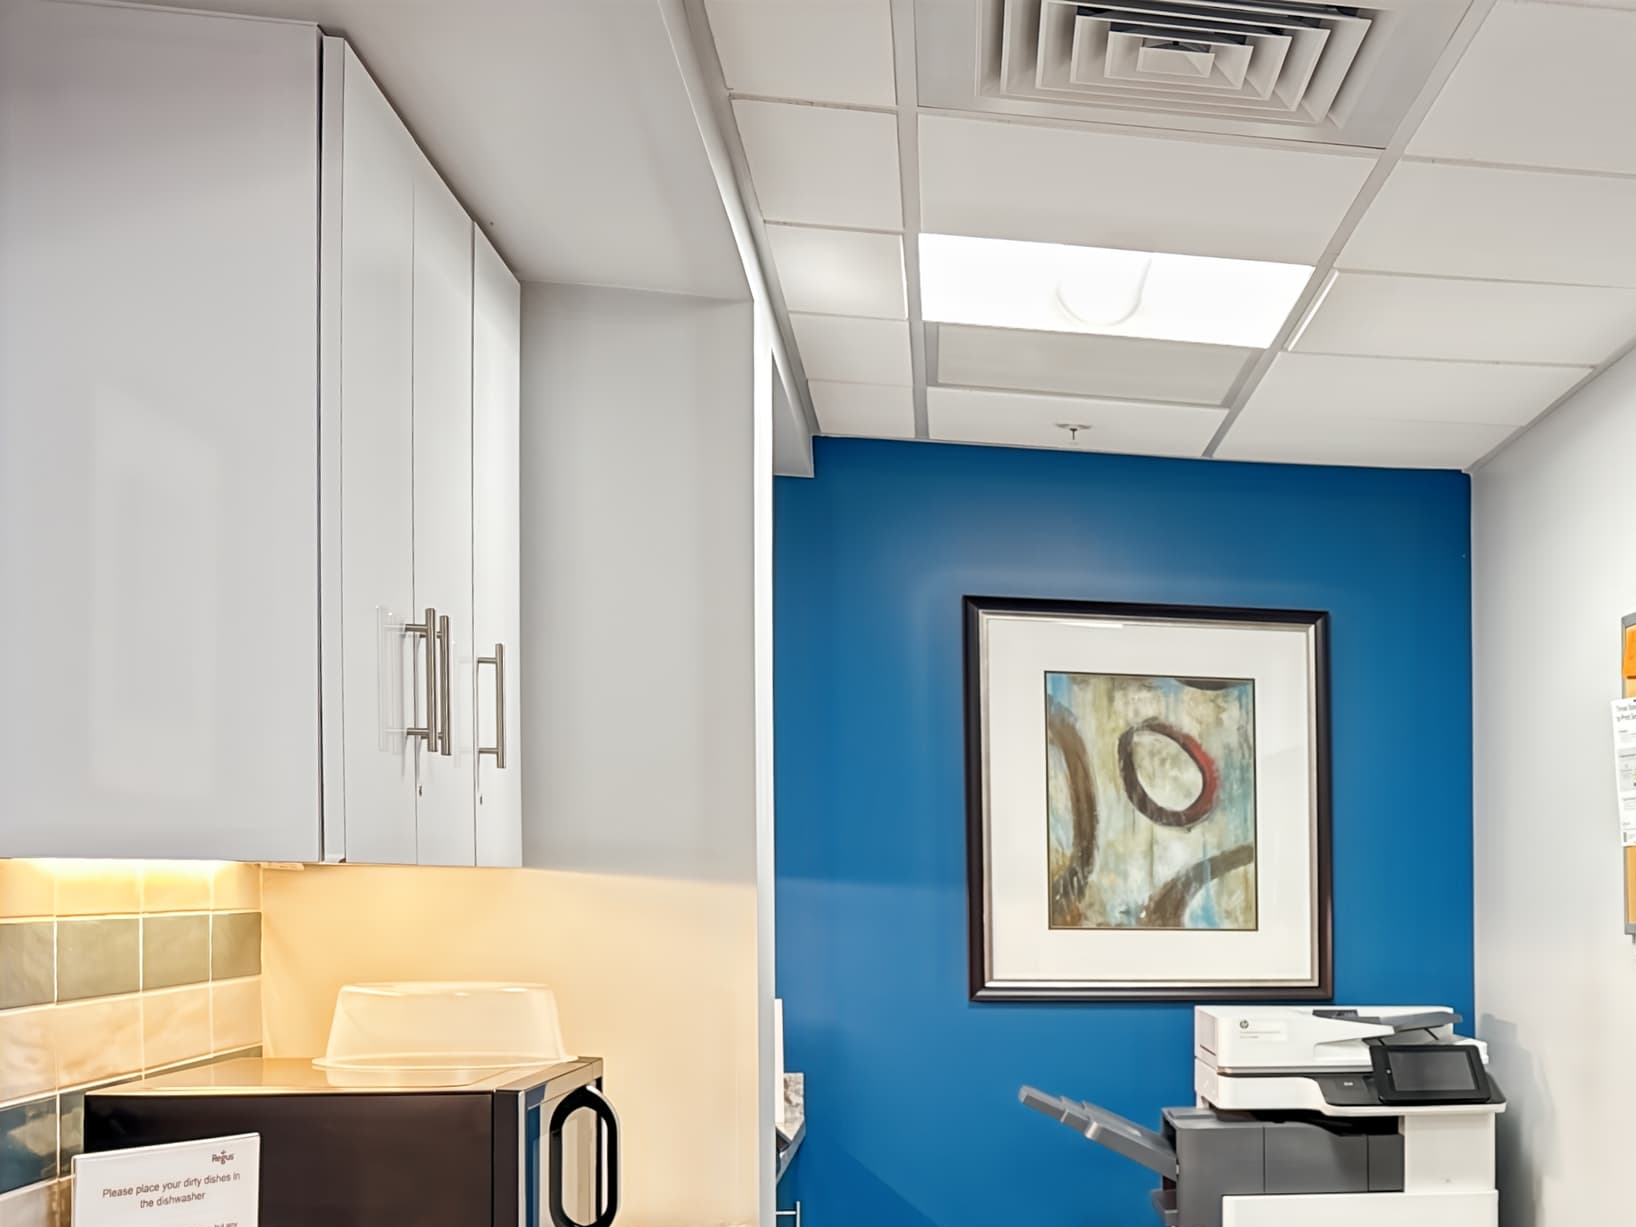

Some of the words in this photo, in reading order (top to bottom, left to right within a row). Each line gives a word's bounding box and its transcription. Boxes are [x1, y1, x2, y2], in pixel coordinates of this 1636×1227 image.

[102, 1186, 134, 1199] Please
[136, 1183, 160, 1196] place
[162, 1180, 181, 1193] your
[183, 1177, 201, 1188] dirty
[204, 1174, 231, 1185] dishes
[233, 1172, 240, 1181] in
[140, 1199, 154, 1208] the
[156, 1191, 205, 1206] dishwasher
